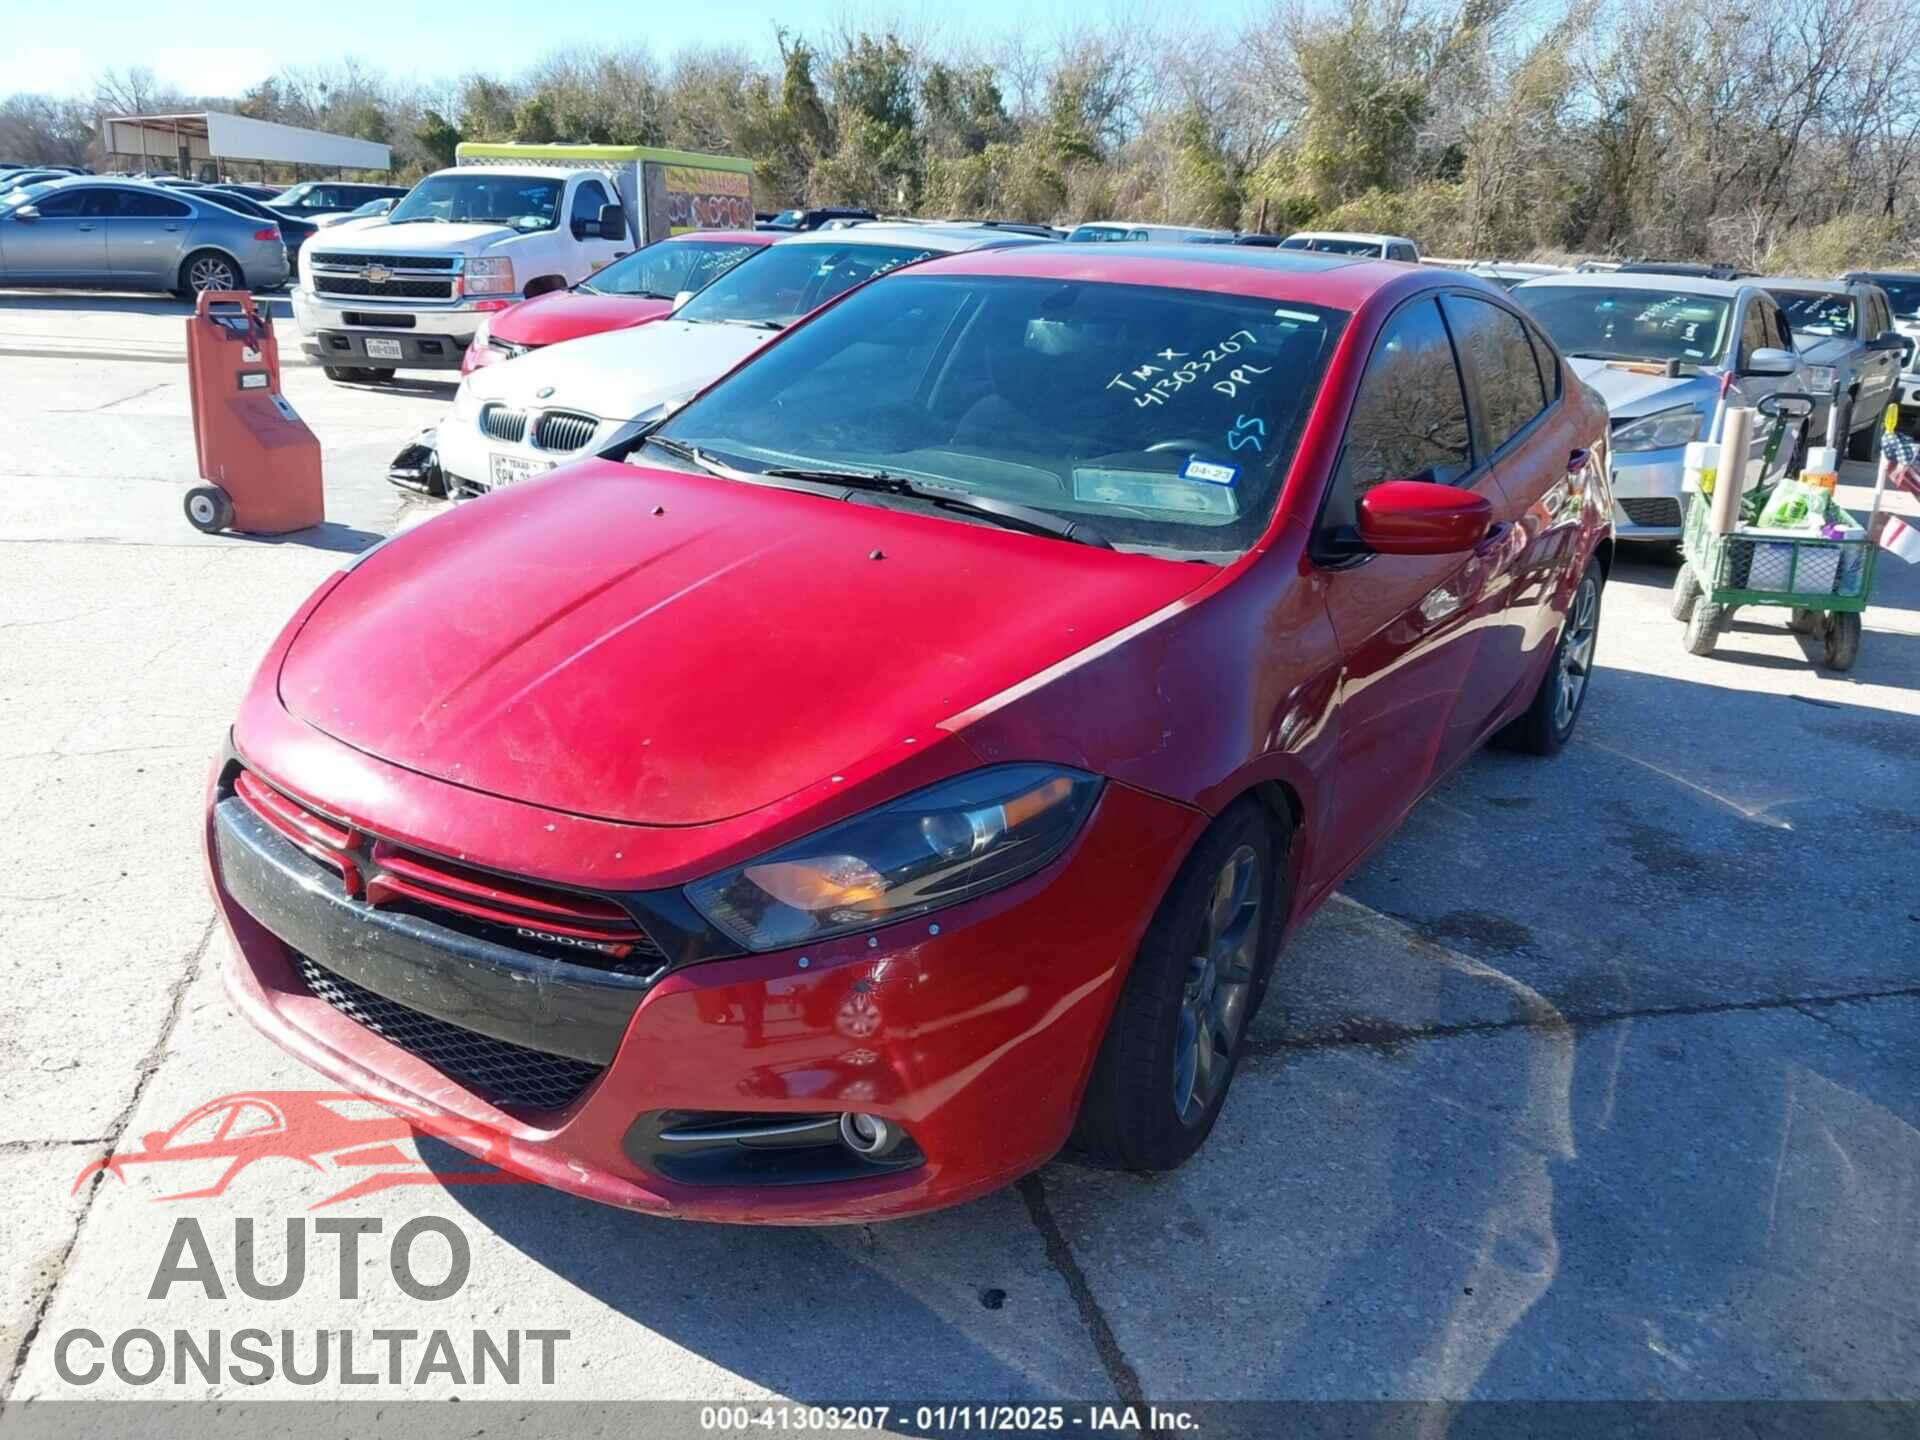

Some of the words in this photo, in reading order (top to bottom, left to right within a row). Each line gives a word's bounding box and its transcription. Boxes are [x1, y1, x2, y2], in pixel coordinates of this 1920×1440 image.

[1134, 330, 1257, 407] 41303207
[1212, 364, 1273, 398] DPL
[1190, 463, 1231, 480] 04-23
[517, 927, 615, 954] DODGE
